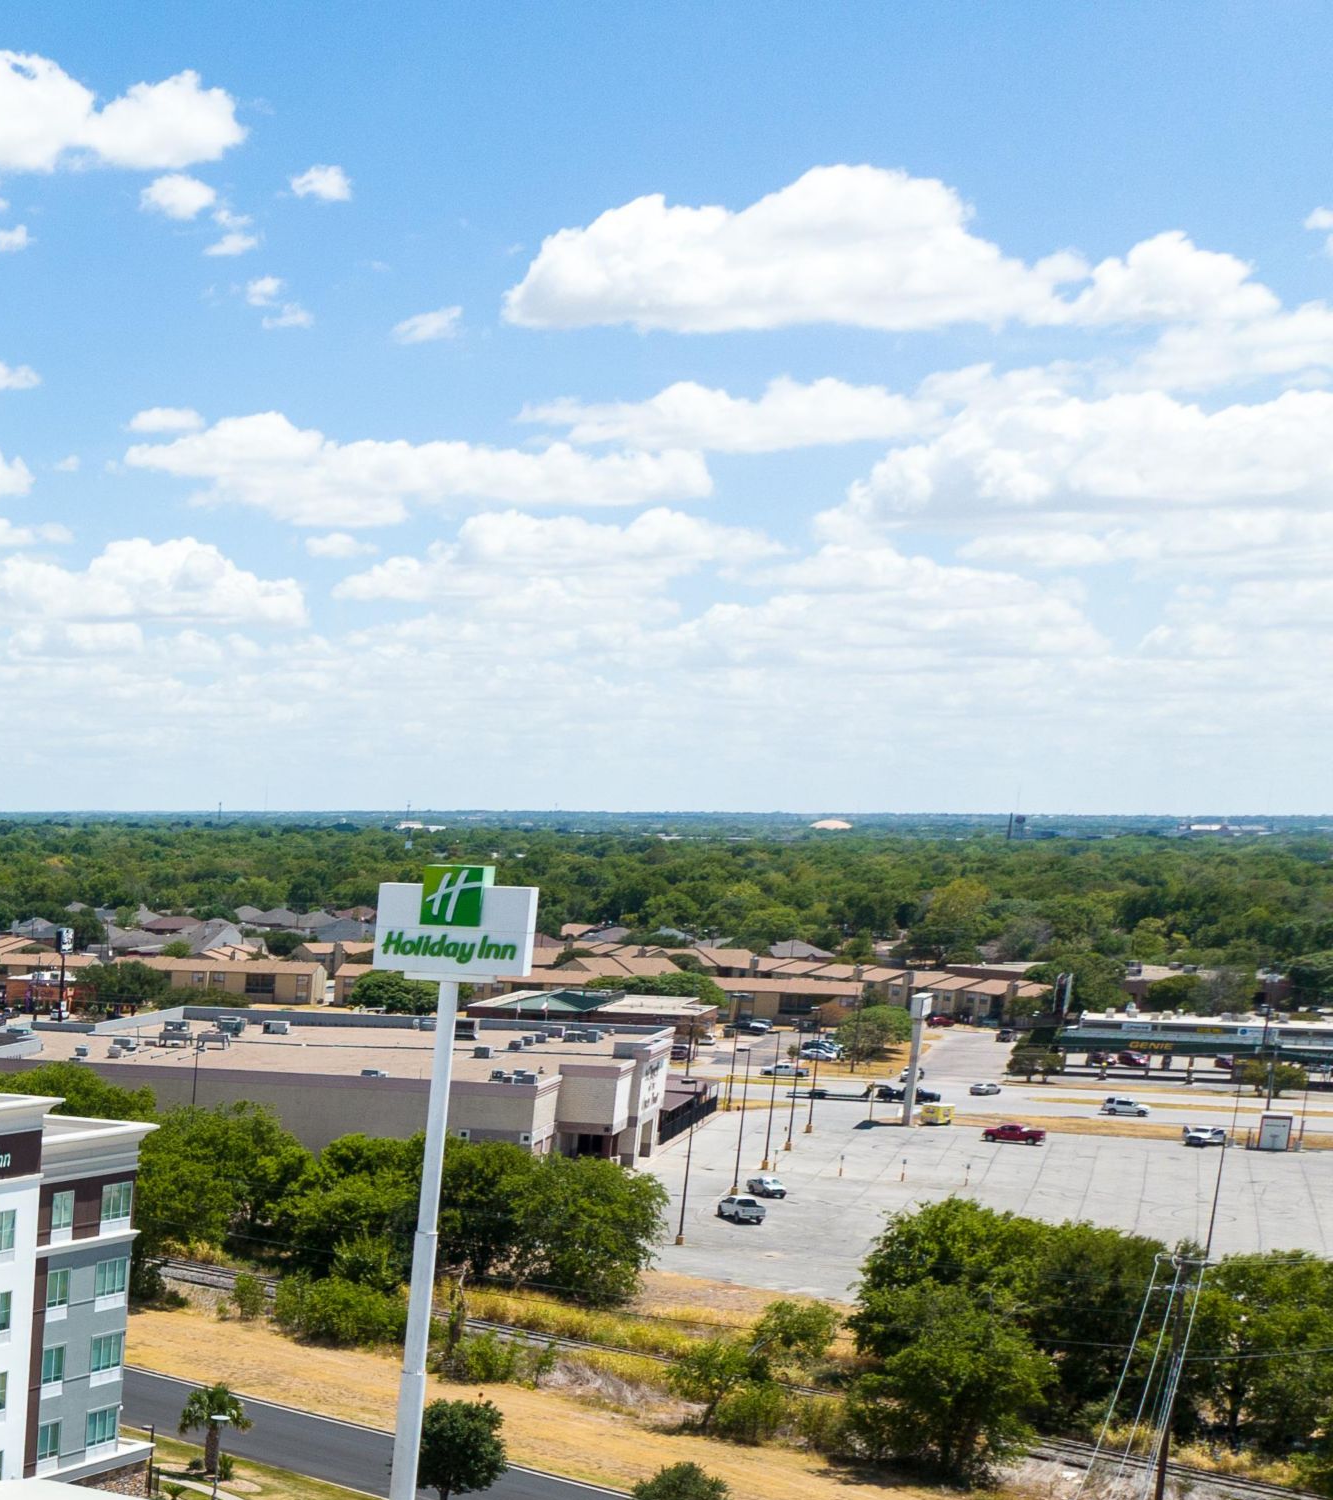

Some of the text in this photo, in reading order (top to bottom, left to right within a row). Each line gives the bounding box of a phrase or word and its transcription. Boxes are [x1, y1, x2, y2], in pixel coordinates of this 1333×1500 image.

[381, 930, 517, 964] Holiday Inn
[1128, 1041, 1174, 1050] GENIE
